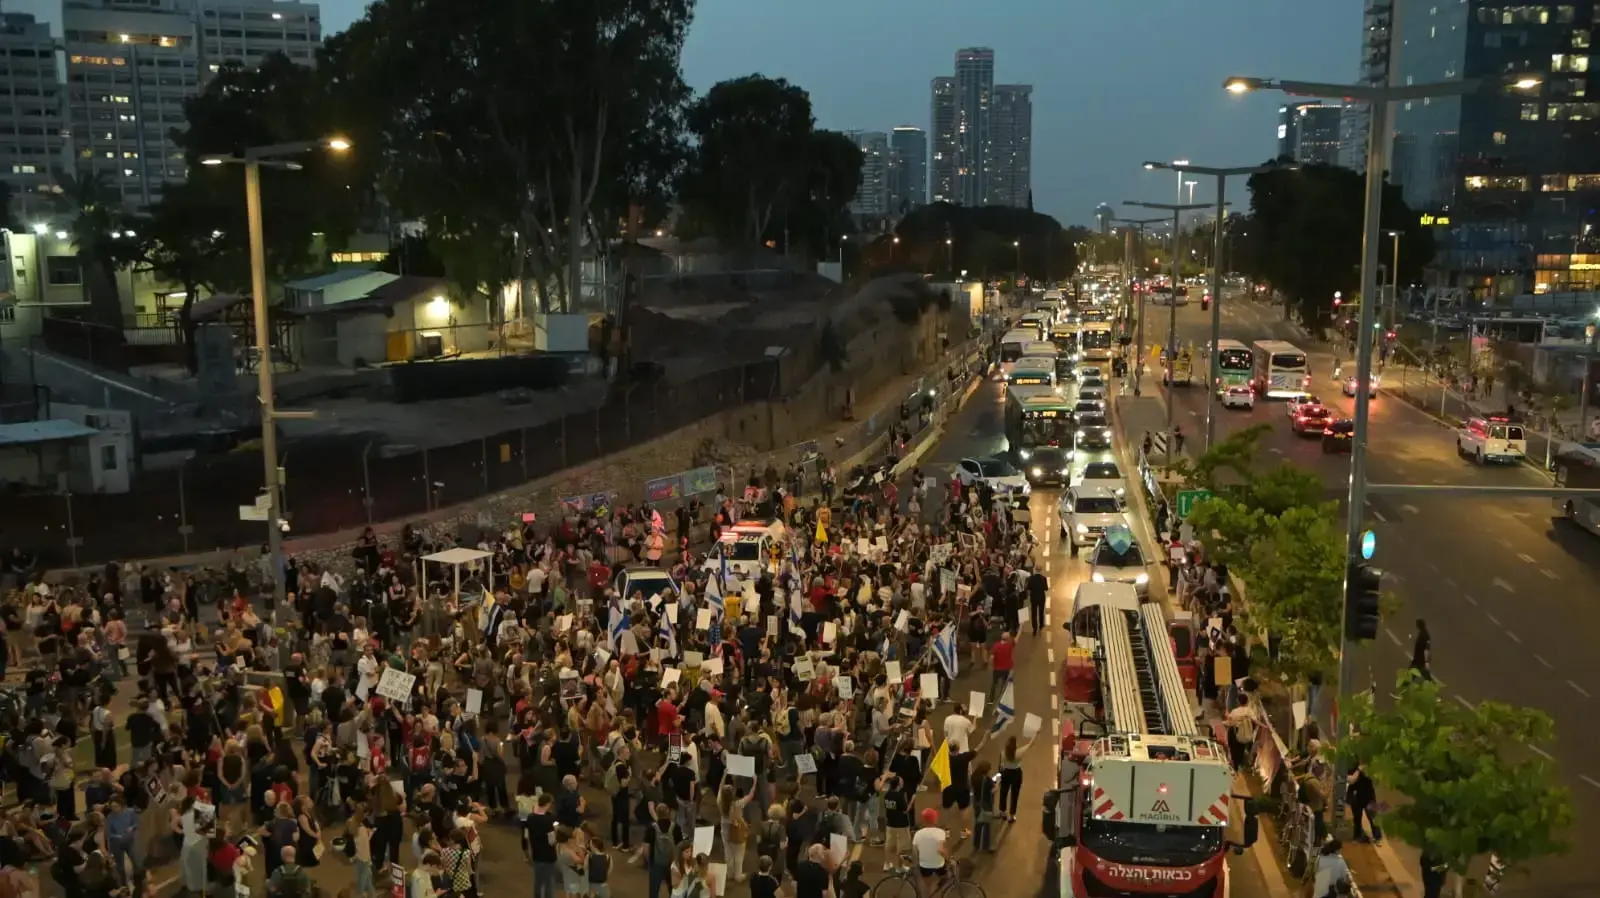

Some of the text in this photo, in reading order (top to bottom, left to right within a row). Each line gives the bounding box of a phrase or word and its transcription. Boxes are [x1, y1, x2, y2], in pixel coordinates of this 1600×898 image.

[1139, 813, 1181, 821] MAGIRUS
[1109, 864, 1192, 880] כבאות והצלה
